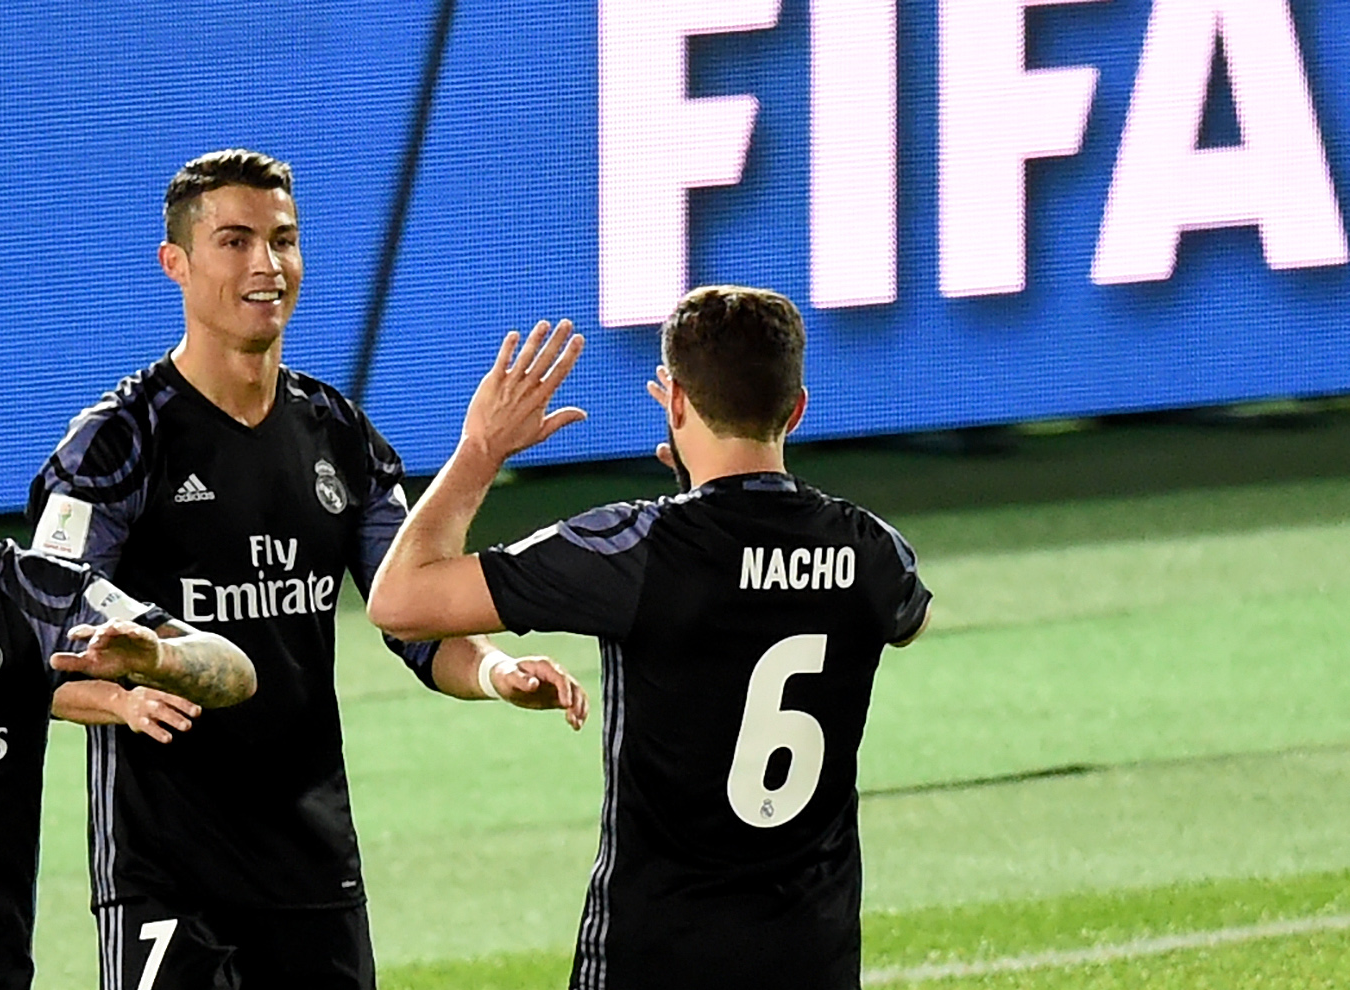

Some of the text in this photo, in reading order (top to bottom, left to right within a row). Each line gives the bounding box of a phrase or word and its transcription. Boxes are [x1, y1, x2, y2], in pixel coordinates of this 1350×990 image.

[598, 0, 1350, 328] FIFA
[249, 534, 298, 571] Fly
[739, 546, 856, 590] NACHO
[726, 633, 828, 829] 6
